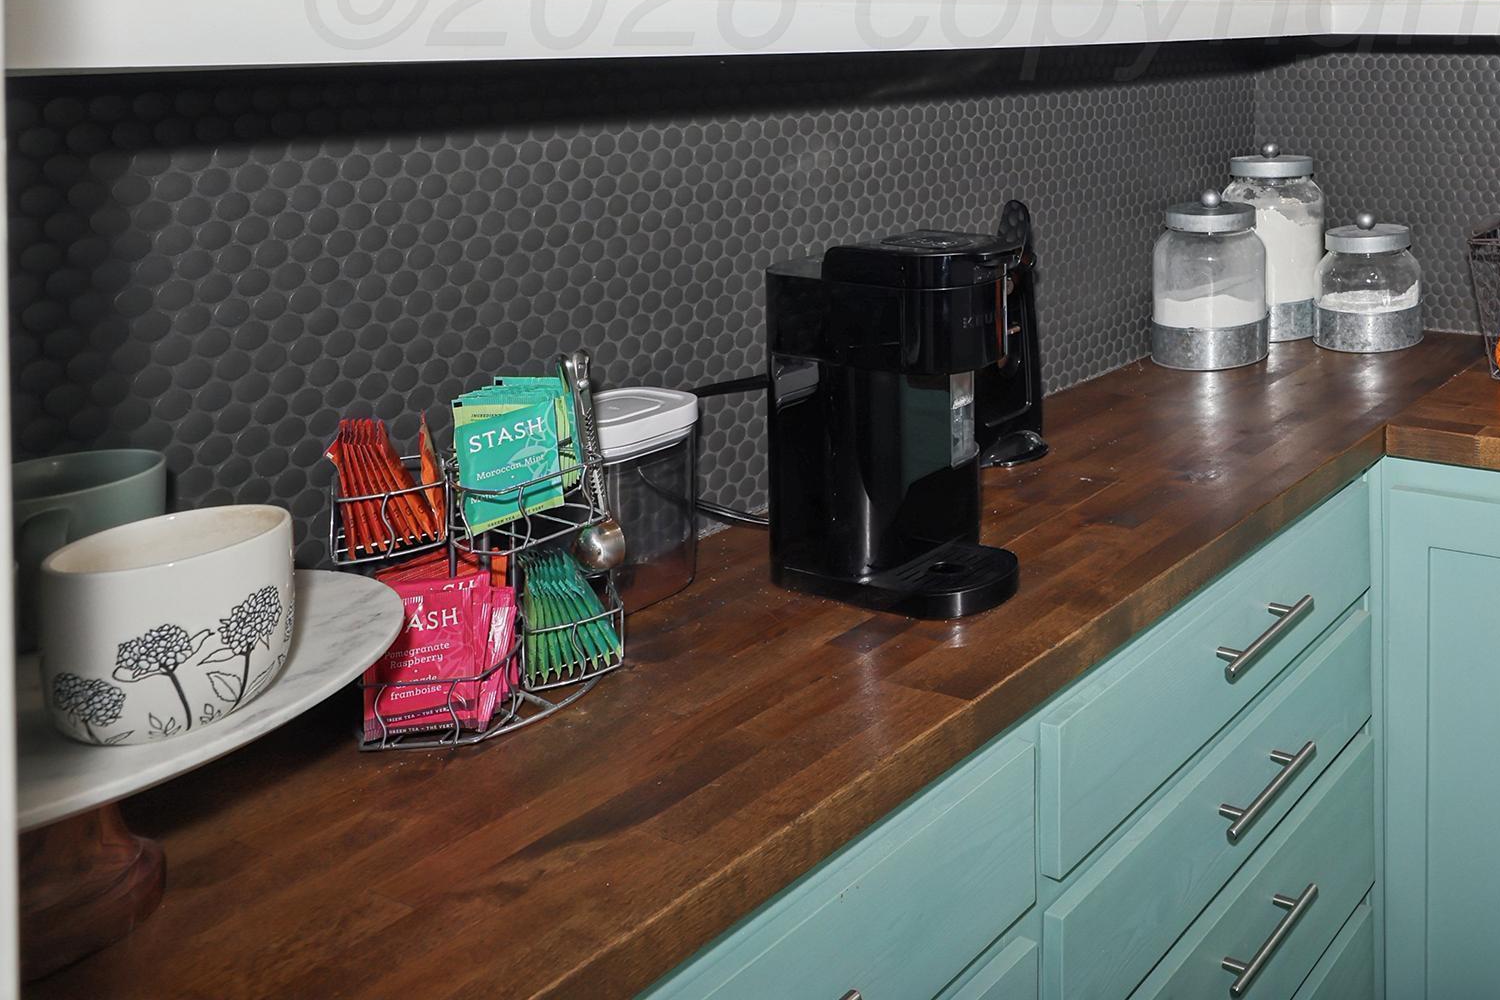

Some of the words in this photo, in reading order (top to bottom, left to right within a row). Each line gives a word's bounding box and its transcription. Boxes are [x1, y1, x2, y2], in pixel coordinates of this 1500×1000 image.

[469, 416, 544, 453] STASH
[476, 462, 522, 481] Moroccan
[524, 454, 545, 467] Mint
[385, 642, 450, 660] Pomegranate
[391, 653, 443, 670] Raspberry
[390, 685, 442, 700] framboise
